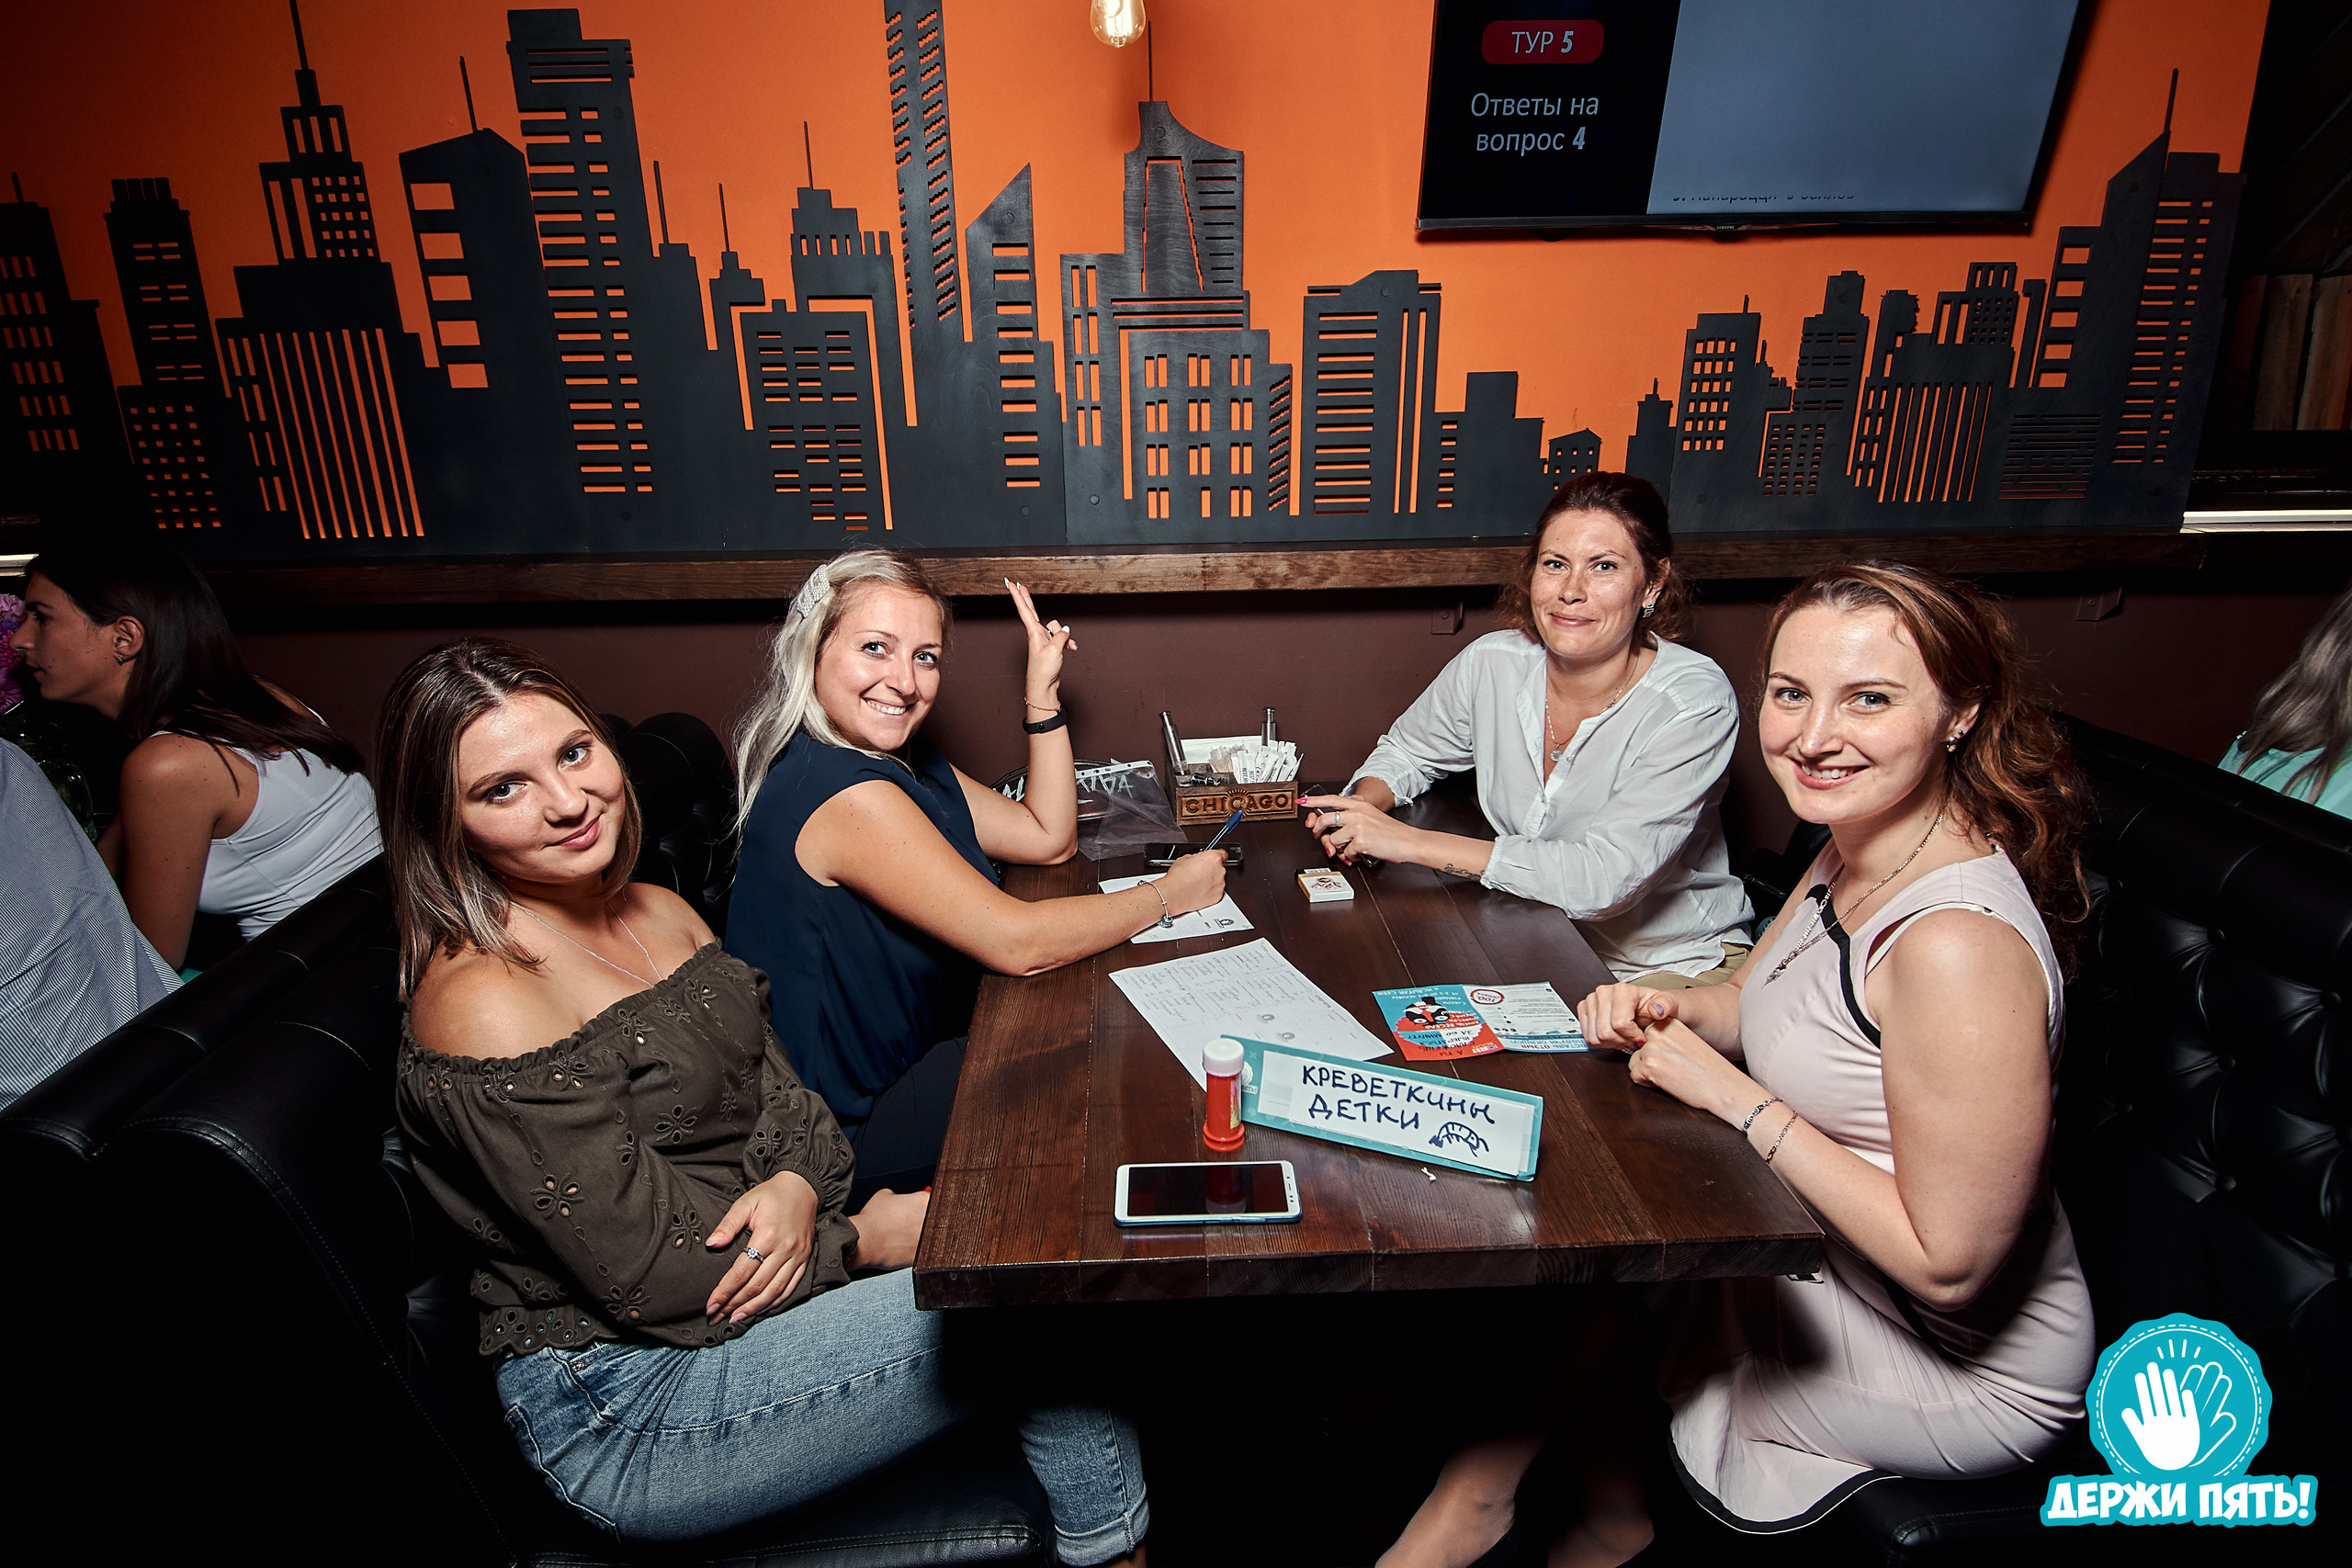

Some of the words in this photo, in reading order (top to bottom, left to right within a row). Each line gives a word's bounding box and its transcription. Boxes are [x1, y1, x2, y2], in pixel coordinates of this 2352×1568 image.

[1511, 30, 1555, 53] ТУР
[1561, 30, 1575, 53] 5
[1471, 93, 1562, 117] Ответы
[1570, 97, 1600, 116] на
[1476, 132, 1566, 157] вопрос
[1572, 127, 1587, 150] 4
[1185, 794, 1289, 813] CHICAGO
[1302, 1066, 1496, 1124] КРЕВЕТКИНЫ
[1308, 1094, 1419, 1130] ДЕТКИ
